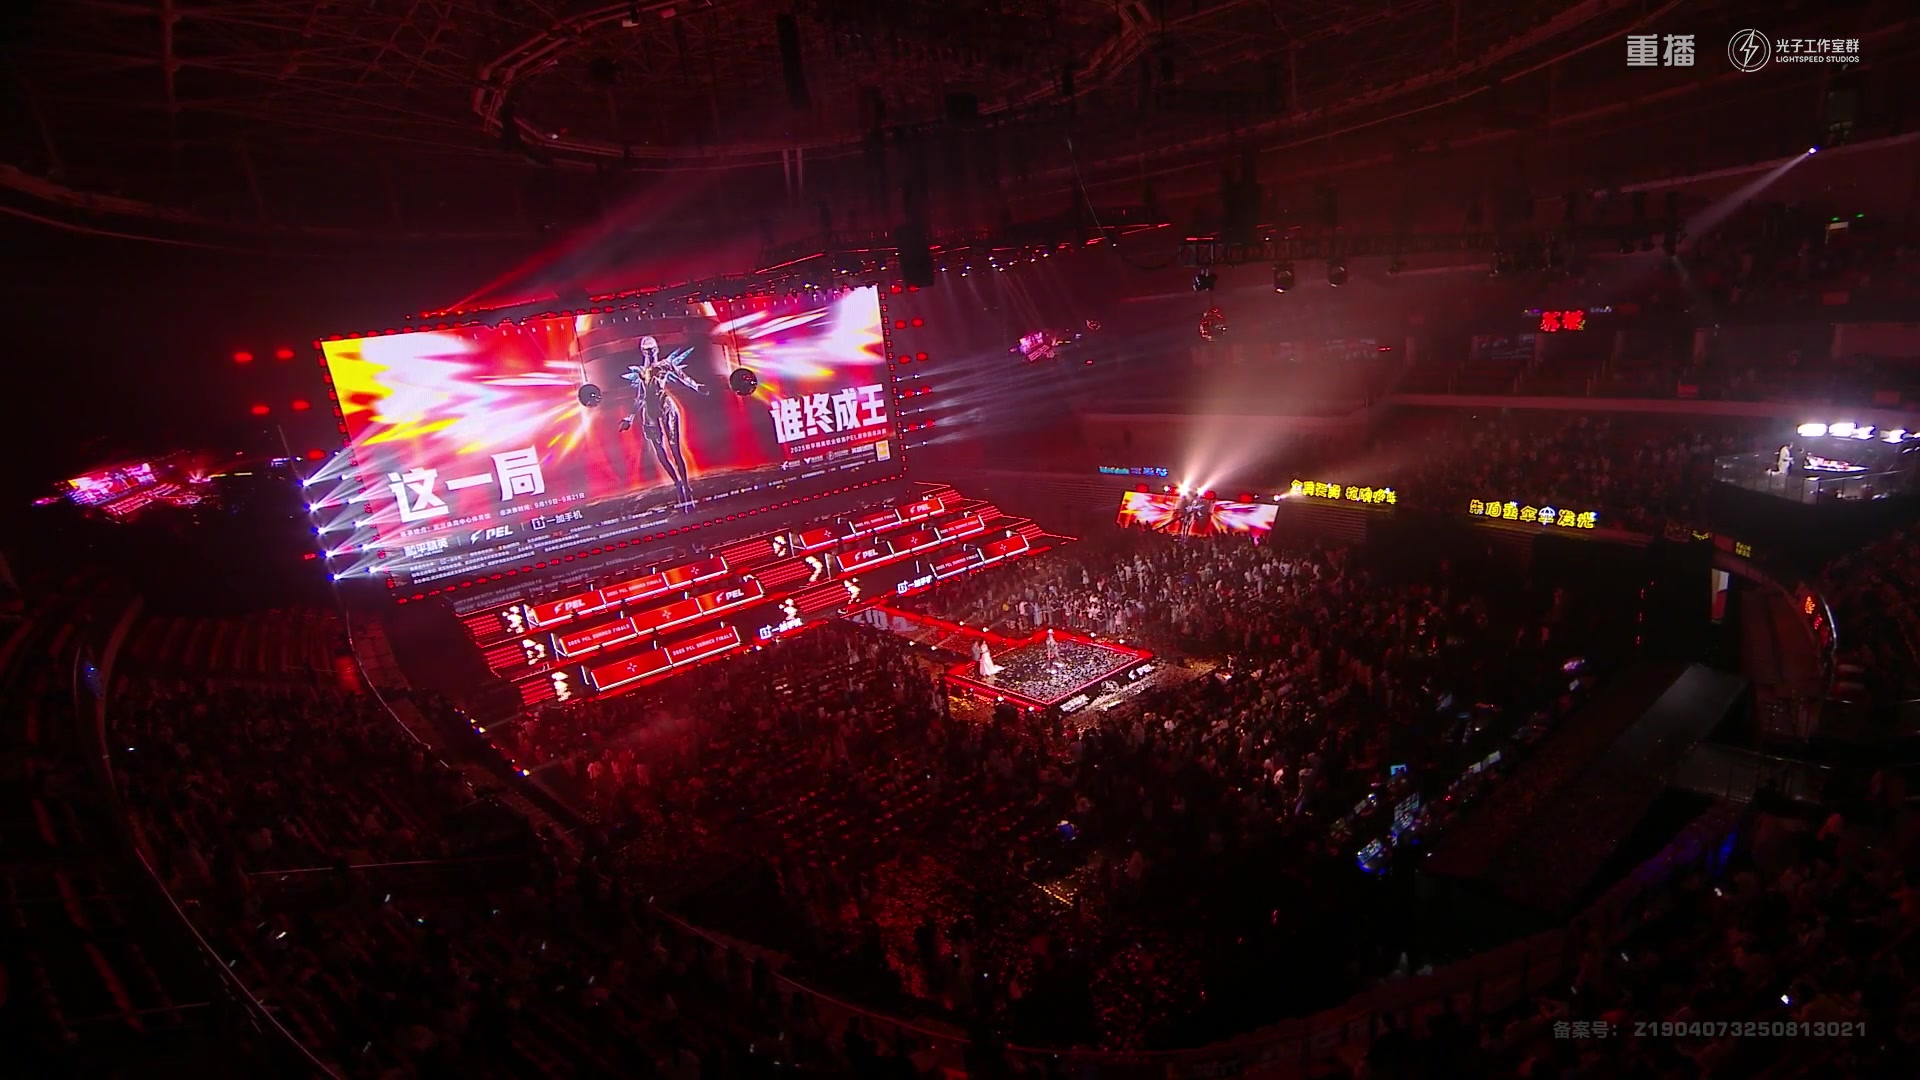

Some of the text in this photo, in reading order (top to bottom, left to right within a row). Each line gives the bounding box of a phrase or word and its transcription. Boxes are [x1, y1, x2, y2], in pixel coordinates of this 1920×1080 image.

[769, 383, 888, 444] 谁终成王
[387, 445, 546, 523] 这一局
[917, 503, 930, 512] PEL
[546, 509, 584, 525] 一加手机
[486, 525, 514, 541] PEL
[862, 548, 879, 559] PEL
[725, 588, 745, 600] PEL
[565, 598, 586, 610] PEL
